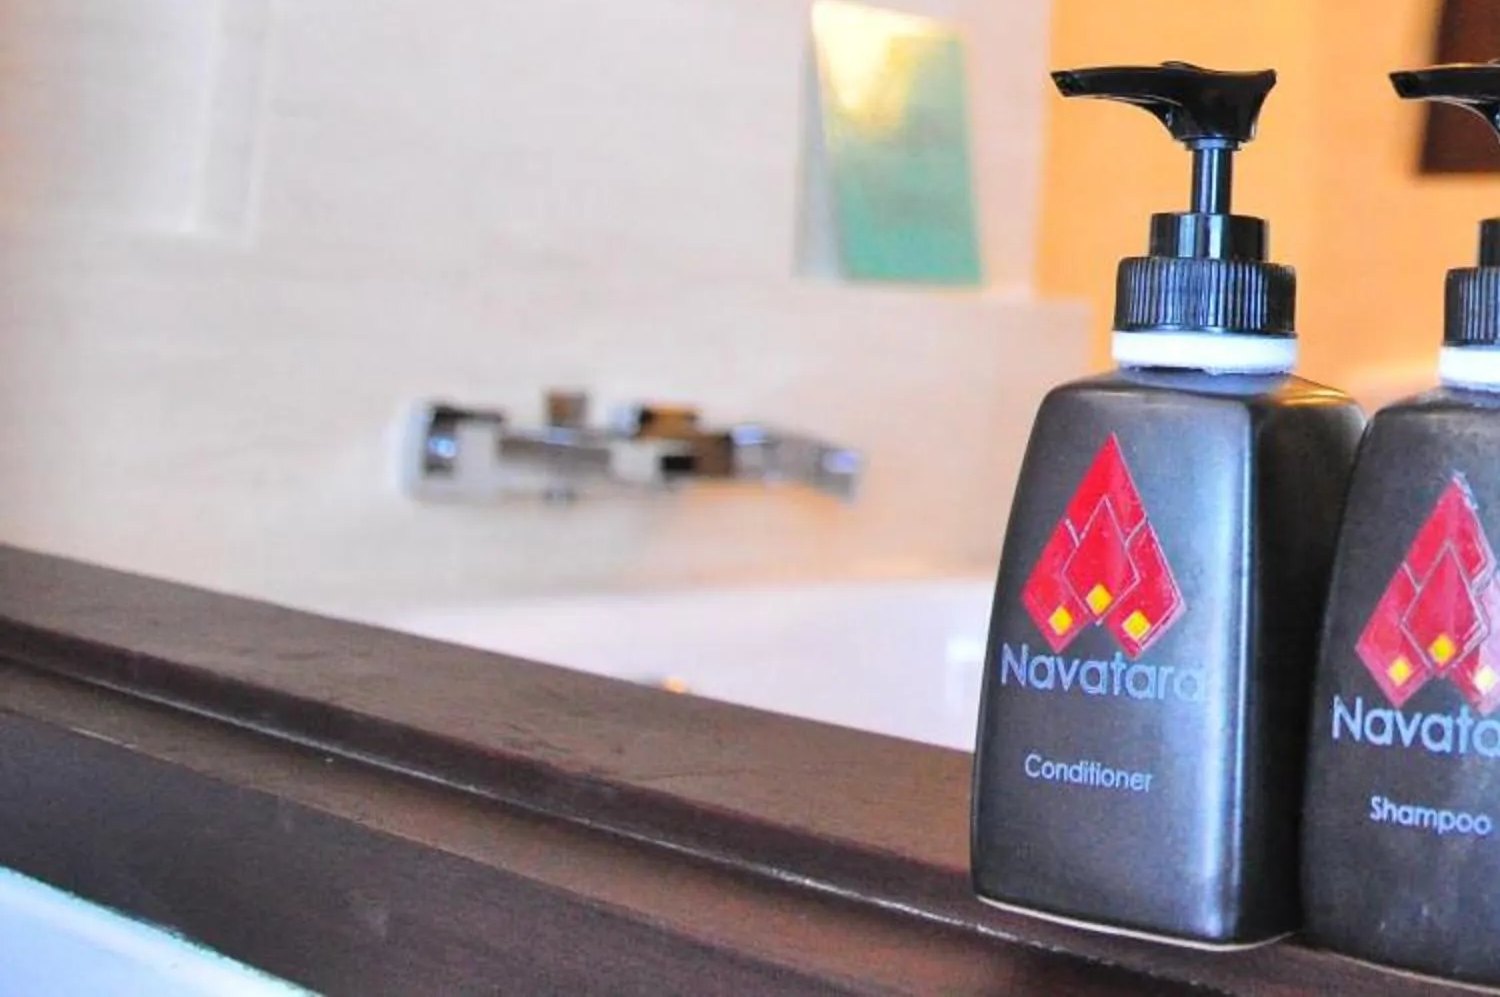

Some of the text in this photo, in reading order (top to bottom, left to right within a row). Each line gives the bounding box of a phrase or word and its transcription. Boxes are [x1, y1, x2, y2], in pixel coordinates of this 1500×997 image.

[1001, 643, 1206, 702] Navatara
[1024, 754, 1152, 792] Conditioner
[1370, 795, 1492, 836] Shampoo
